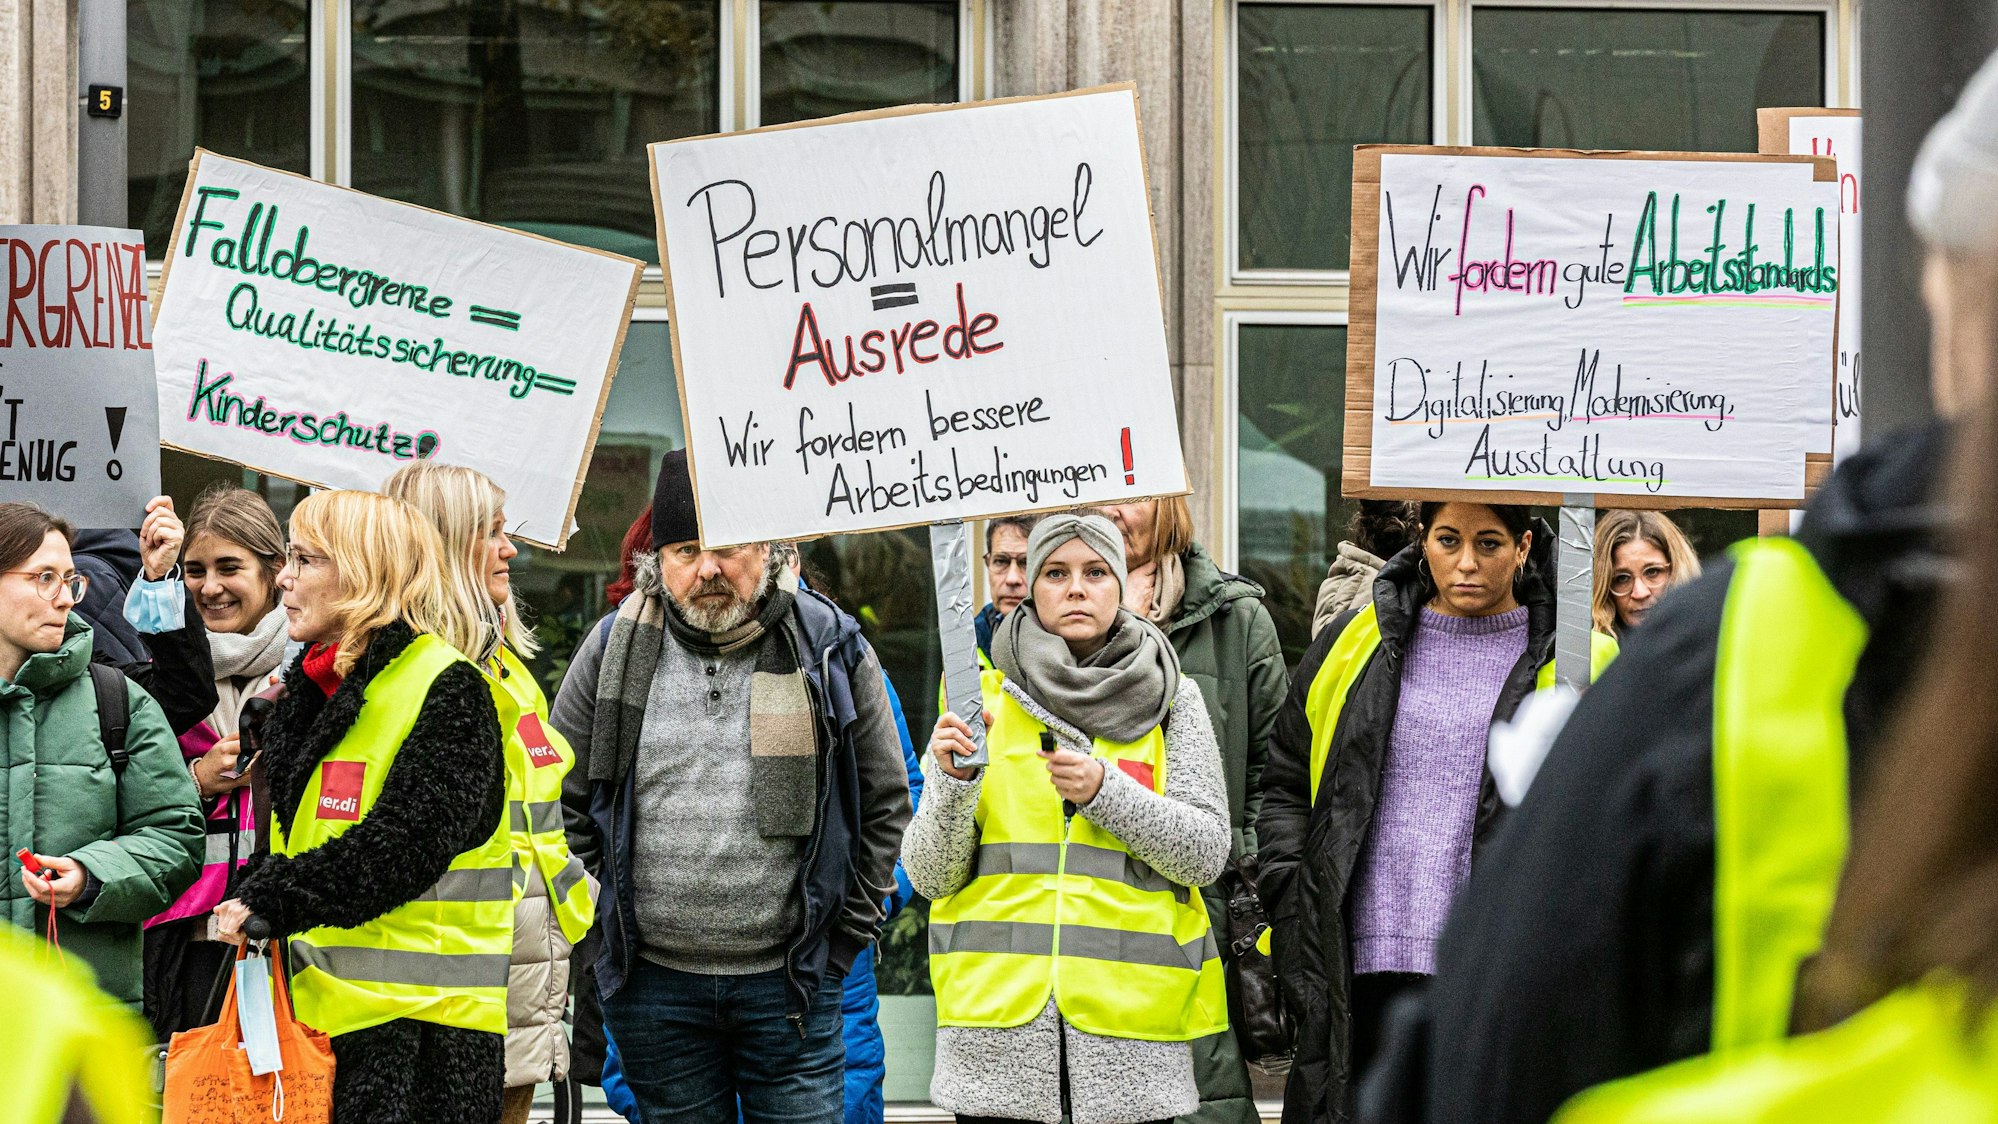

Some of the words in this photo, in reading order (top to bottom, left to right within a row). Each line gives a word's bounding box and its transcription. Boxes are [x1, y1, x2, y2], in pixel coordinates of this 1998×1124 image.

[100, 90, 112, 110] 5
[185, 186, 454, 319] Fallobergrenze
[686, 162, 1104, 298] Personalmangel
[1386, 184, 1452, 292] Wir
[1448, 183, 1559, 316] fordern
[1563, 213, 1626, 309] gute
[1623, 190, 1839, 295] Arbeitsstandards
[783, 282, 1005, 390] Ausrede
[718, 411, 775, 468] Wir
[796, 402, 907, 474] fordern
[925, 389, 1051, 441] bessere
[1464, 423, 1665, 493] Ausstattung
[826, 447, 1108, 517] Arbeitsbedingungen
